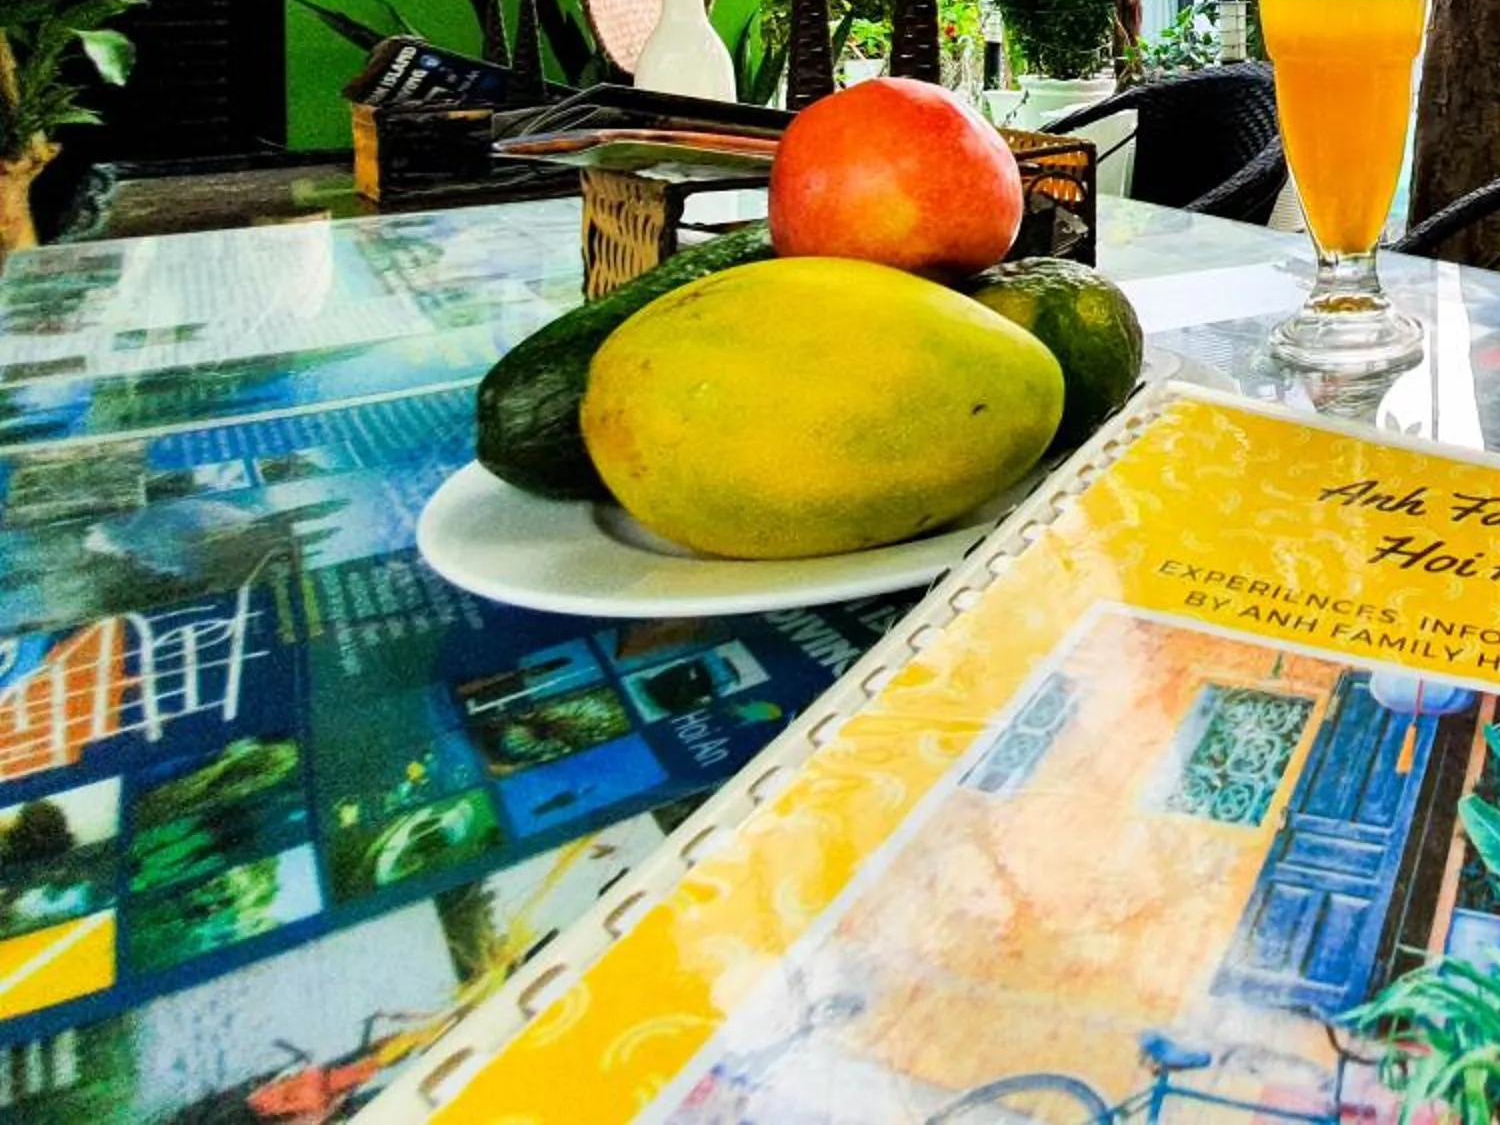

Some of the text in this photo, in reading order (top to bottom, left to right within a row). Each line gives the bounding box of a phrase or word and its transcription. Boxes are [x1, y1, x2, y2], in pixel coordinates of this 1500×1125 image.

[1317, 479, 1429, 517] Anh
[1367, 535, 1485, 578] Hoi
[1184, 590, 1231, 612] BY
[1238, 605, 1318, 633] ANH
[1331, 622, 1464, 663] FAMILY
